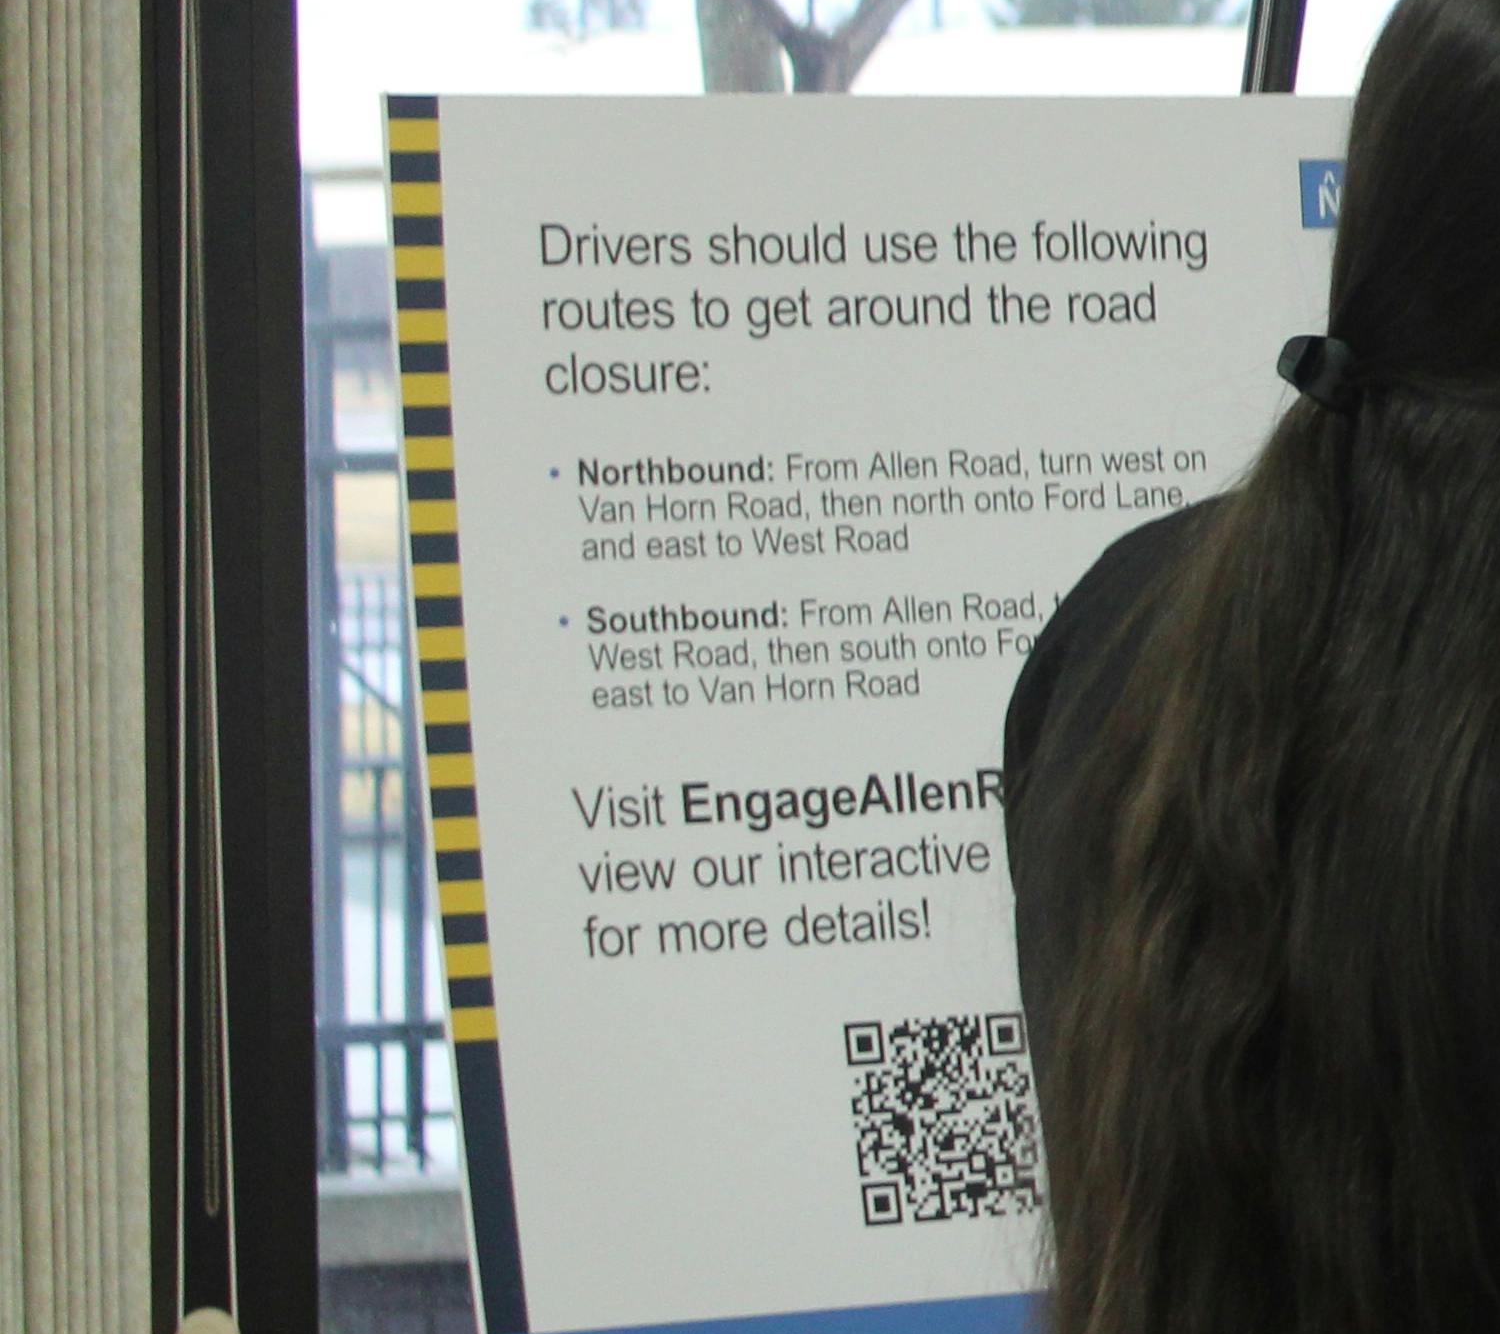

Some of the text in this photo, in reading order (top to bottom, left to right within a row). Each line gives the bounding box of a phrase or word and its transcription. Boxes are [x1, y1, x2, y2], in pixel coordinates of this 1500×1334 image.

[539, 219, 1208, 272] Drivers should use the following
[542, 280, 1157, 340] routes to get around the road
[545, 352, 711, 396] closure:
[577, 446, 1207, 487] Northbound: From Allen Road, turn west on
[578, 481, 1191, 523] Van Horn Road, then north onto Ford Lane,
[582, 523, 909, 561] and east to West Road
[586, 599, 788, 635] Southbound:
[800, 598, 872, 627] From
[882, 595, 952, 624] Allen
[962, 591, 1045, 623] Road,
[588, 642, 663, 672] West
[673, 637, 757, 670] Road,
[767, 636, 829, 666] then
[840, 632, 917, 663] south
[926, 631, 987, 659] onto
[592, 668, 920, 709] east to Van Horn Road
[571, 769, 1005, 835] Visit EngageAllenR
[578, 836, 991, 894] view our interactive
[583, 896, 931, 959] for more details!
